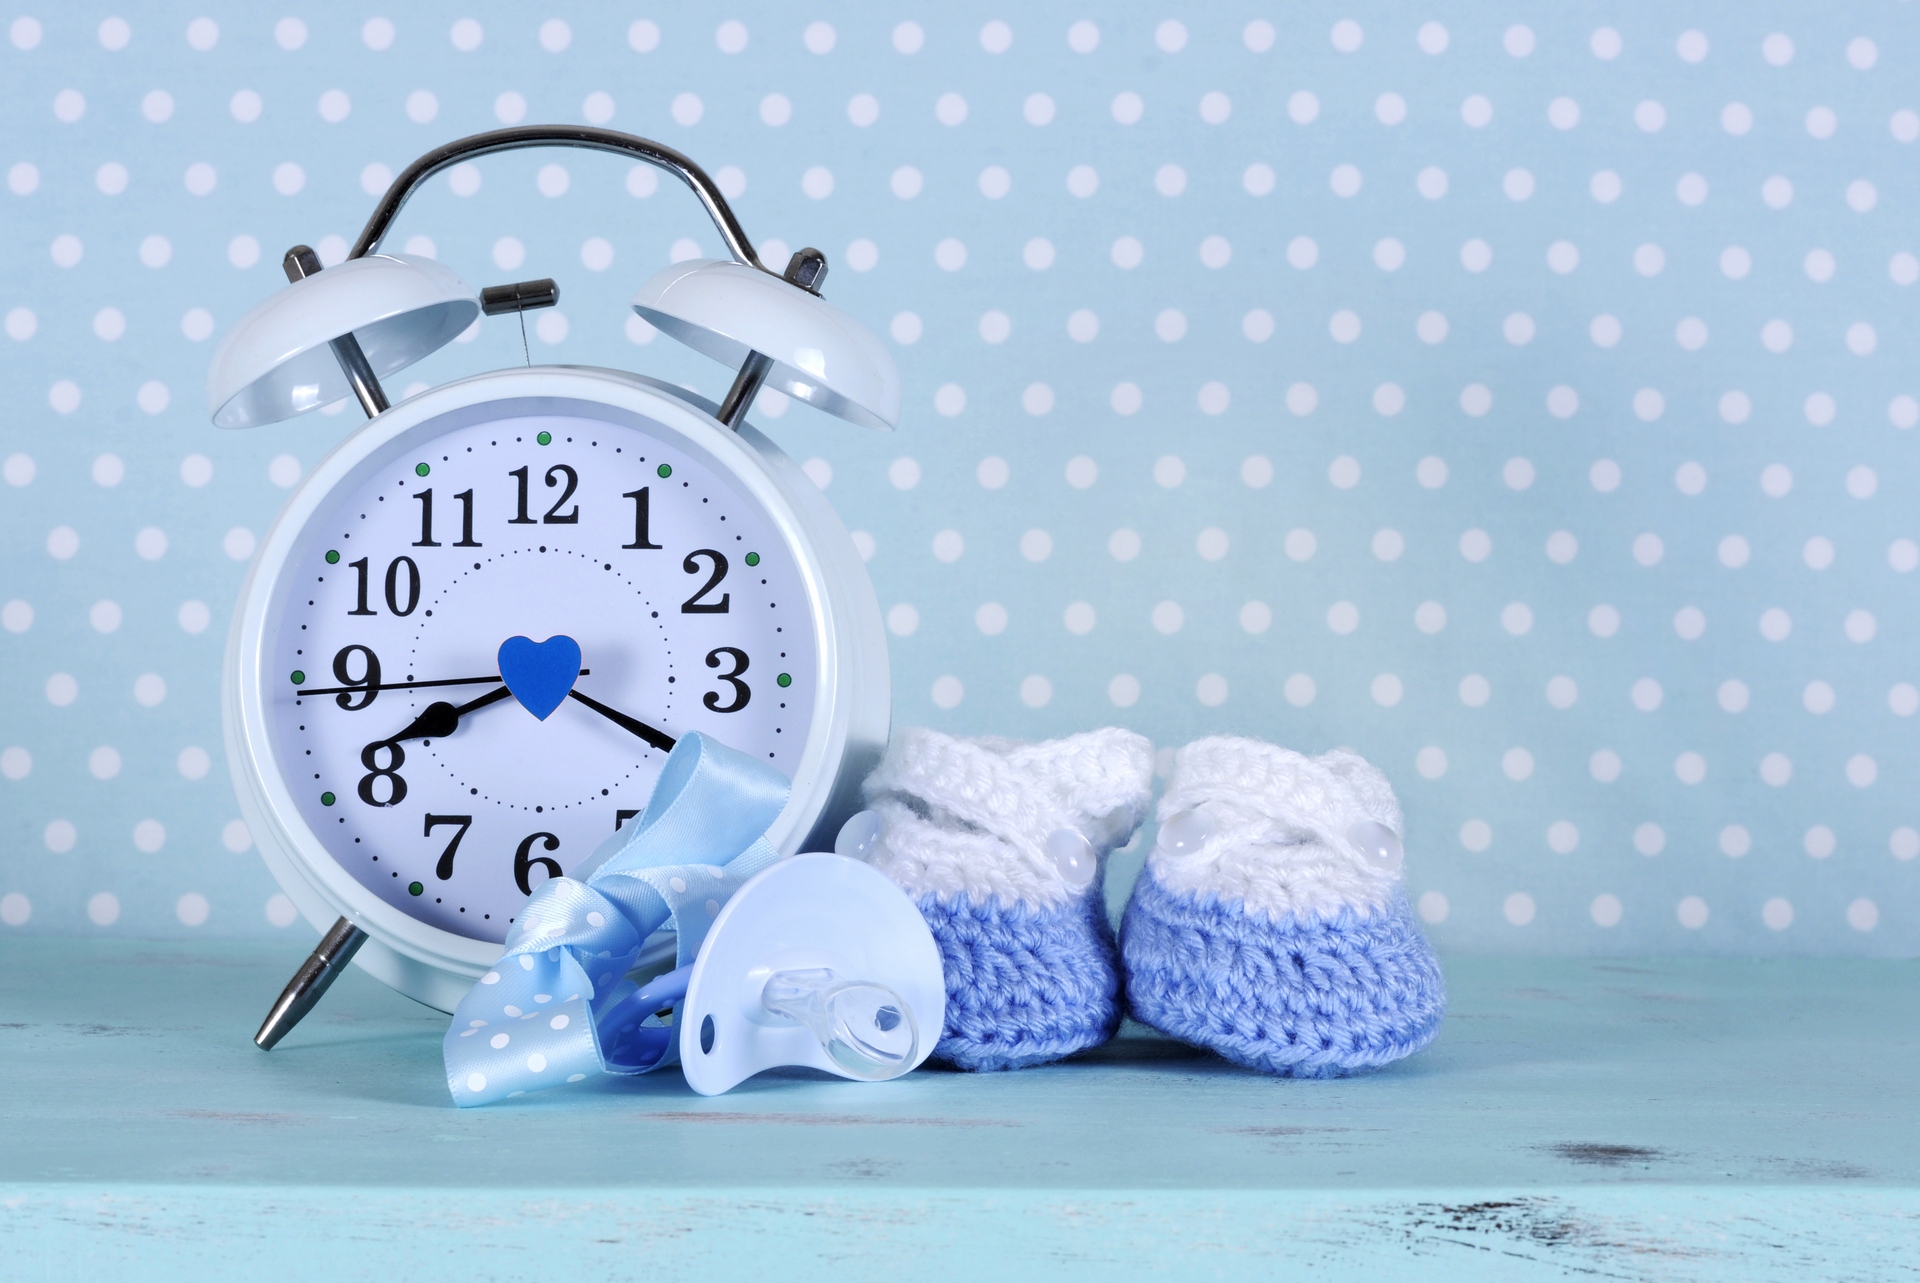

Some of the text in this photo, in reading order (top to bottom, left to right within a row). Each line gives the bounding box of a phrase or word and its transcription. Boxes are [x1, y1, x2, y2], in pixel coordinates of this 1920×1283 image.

[411, 488, 483, 547] 11
[508, 464, 579, 524] 12
[621, 486, 663, 549] 1
[347, 556, 421, 617] 10
[681, 548, 730, 614] 2
[332, 644, 381, 711] 9
[703, 646, 751, 713] 3
[358, 740, 408, 807] 8
[424, 812, 472, 880] 7
[514, 831, 563, 897] 6
